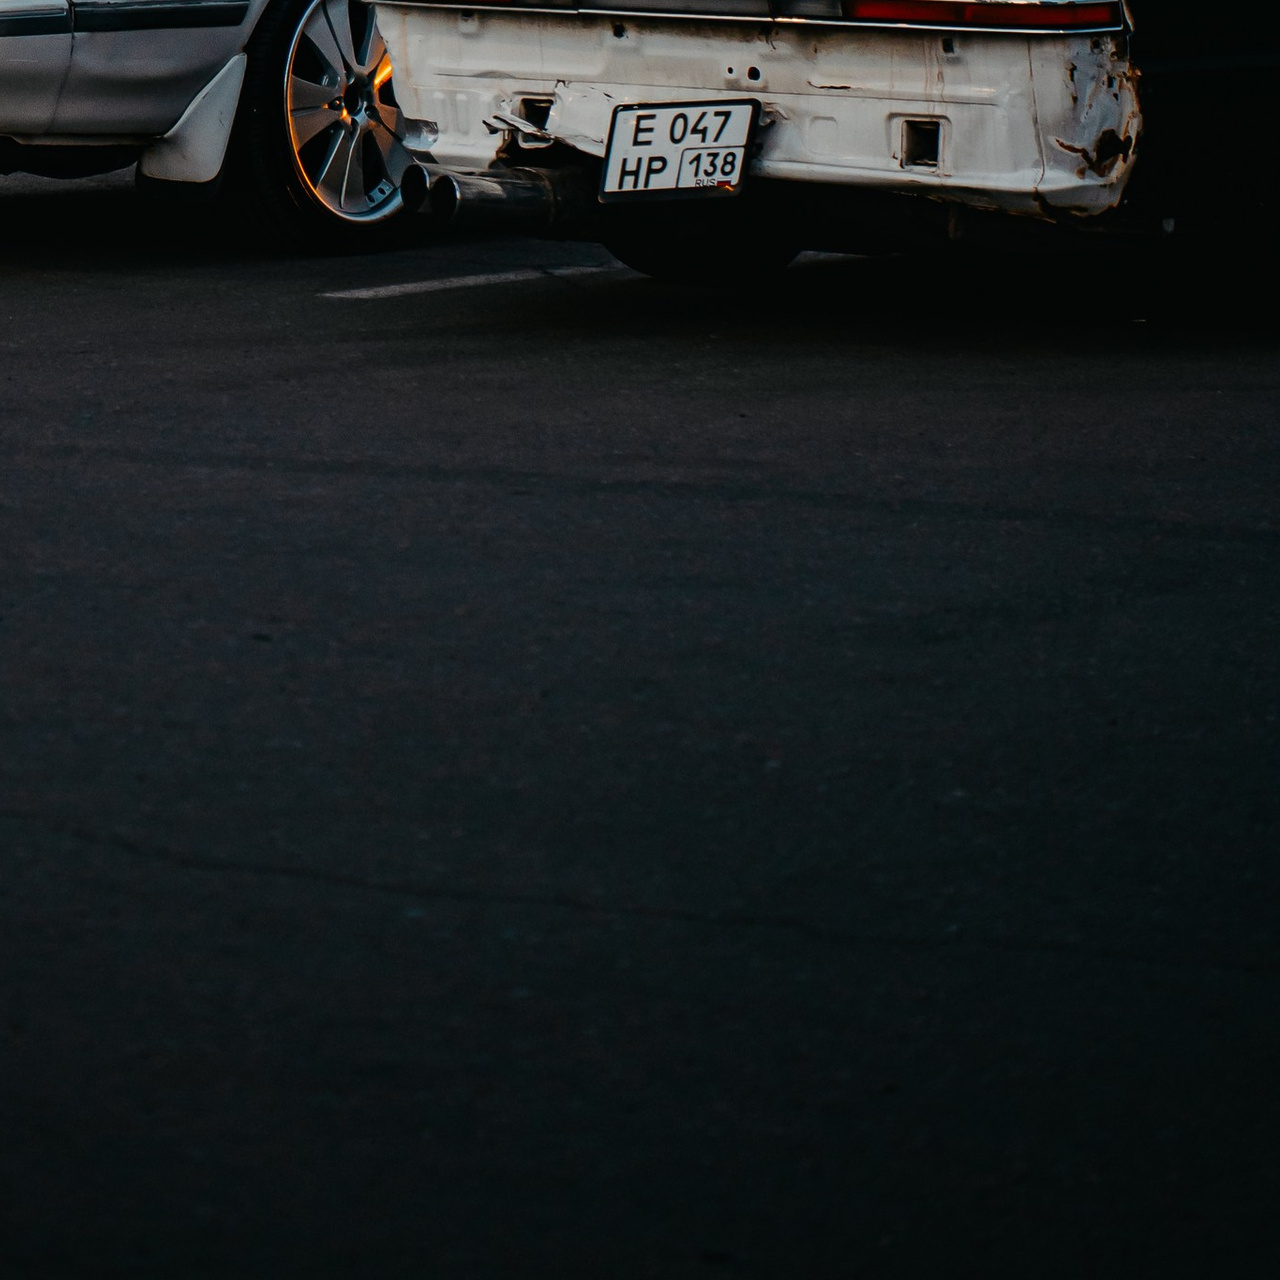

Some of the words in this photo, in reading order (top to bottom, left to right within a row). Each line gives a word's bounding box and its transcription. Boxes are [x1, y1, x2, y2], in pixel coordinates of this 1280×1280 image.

[669, 111, 732, 144] 047
[689, 151, 737, 178] 138
[695, 178, 716, 187] RUS
